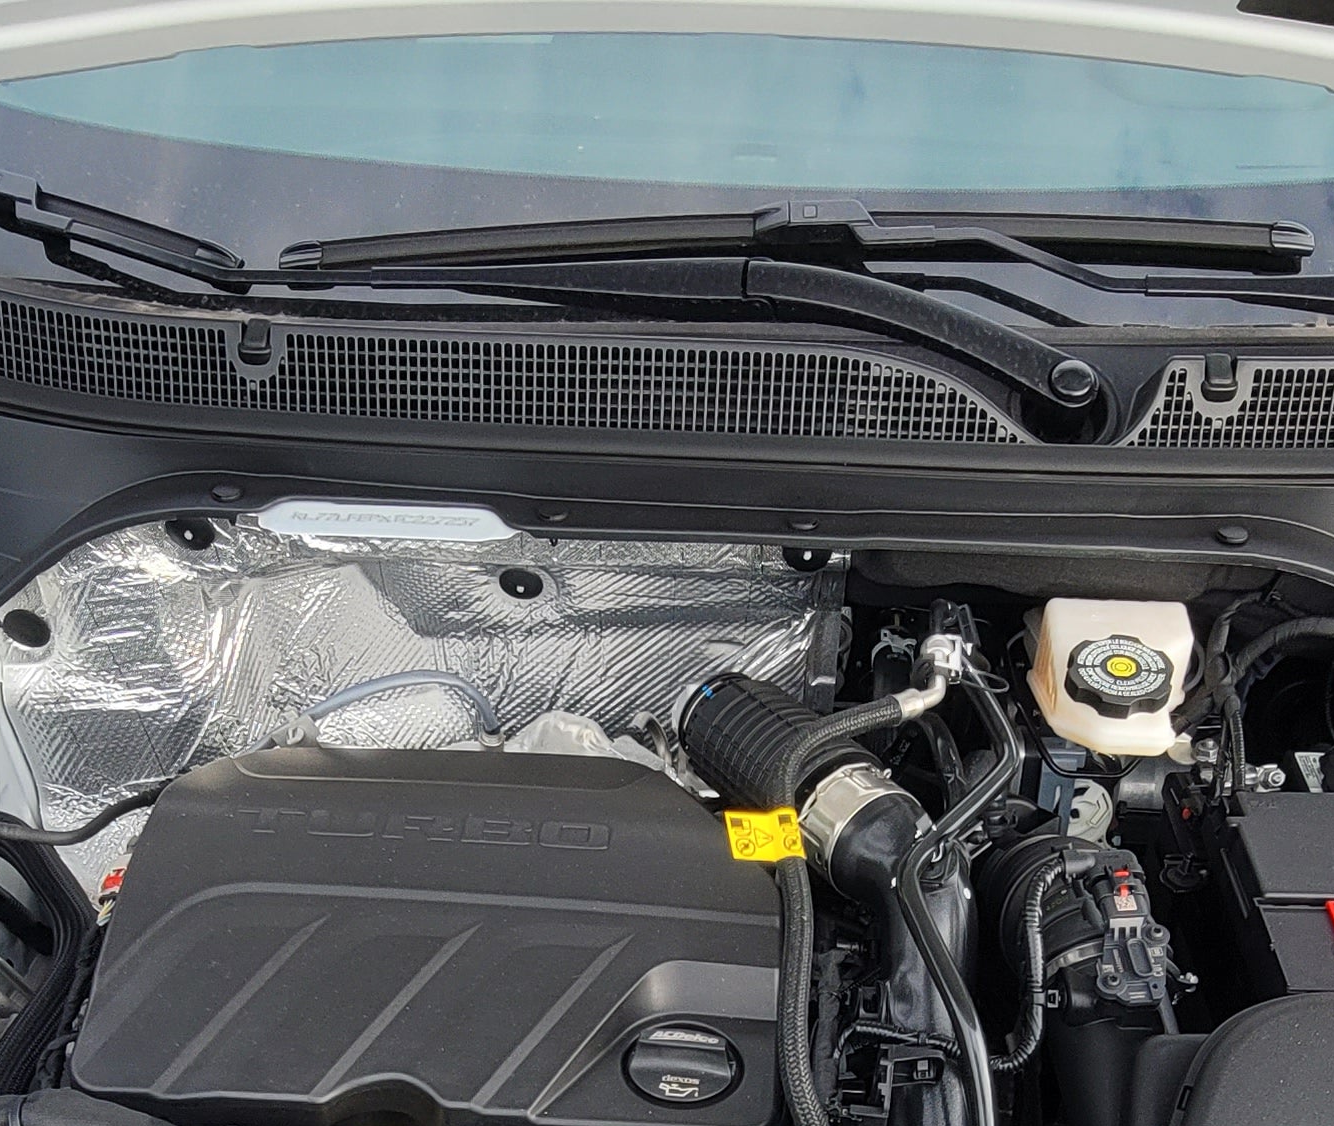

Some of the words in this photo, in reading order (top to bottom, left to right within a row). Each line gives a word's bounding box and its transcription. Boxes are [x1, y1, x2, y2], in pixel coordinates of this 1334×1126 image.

[238, 808, 610, 850] TURBO
[648, 1031, 719, 1044] ACDelco
[661, 1074, 701, 1085] dexos
